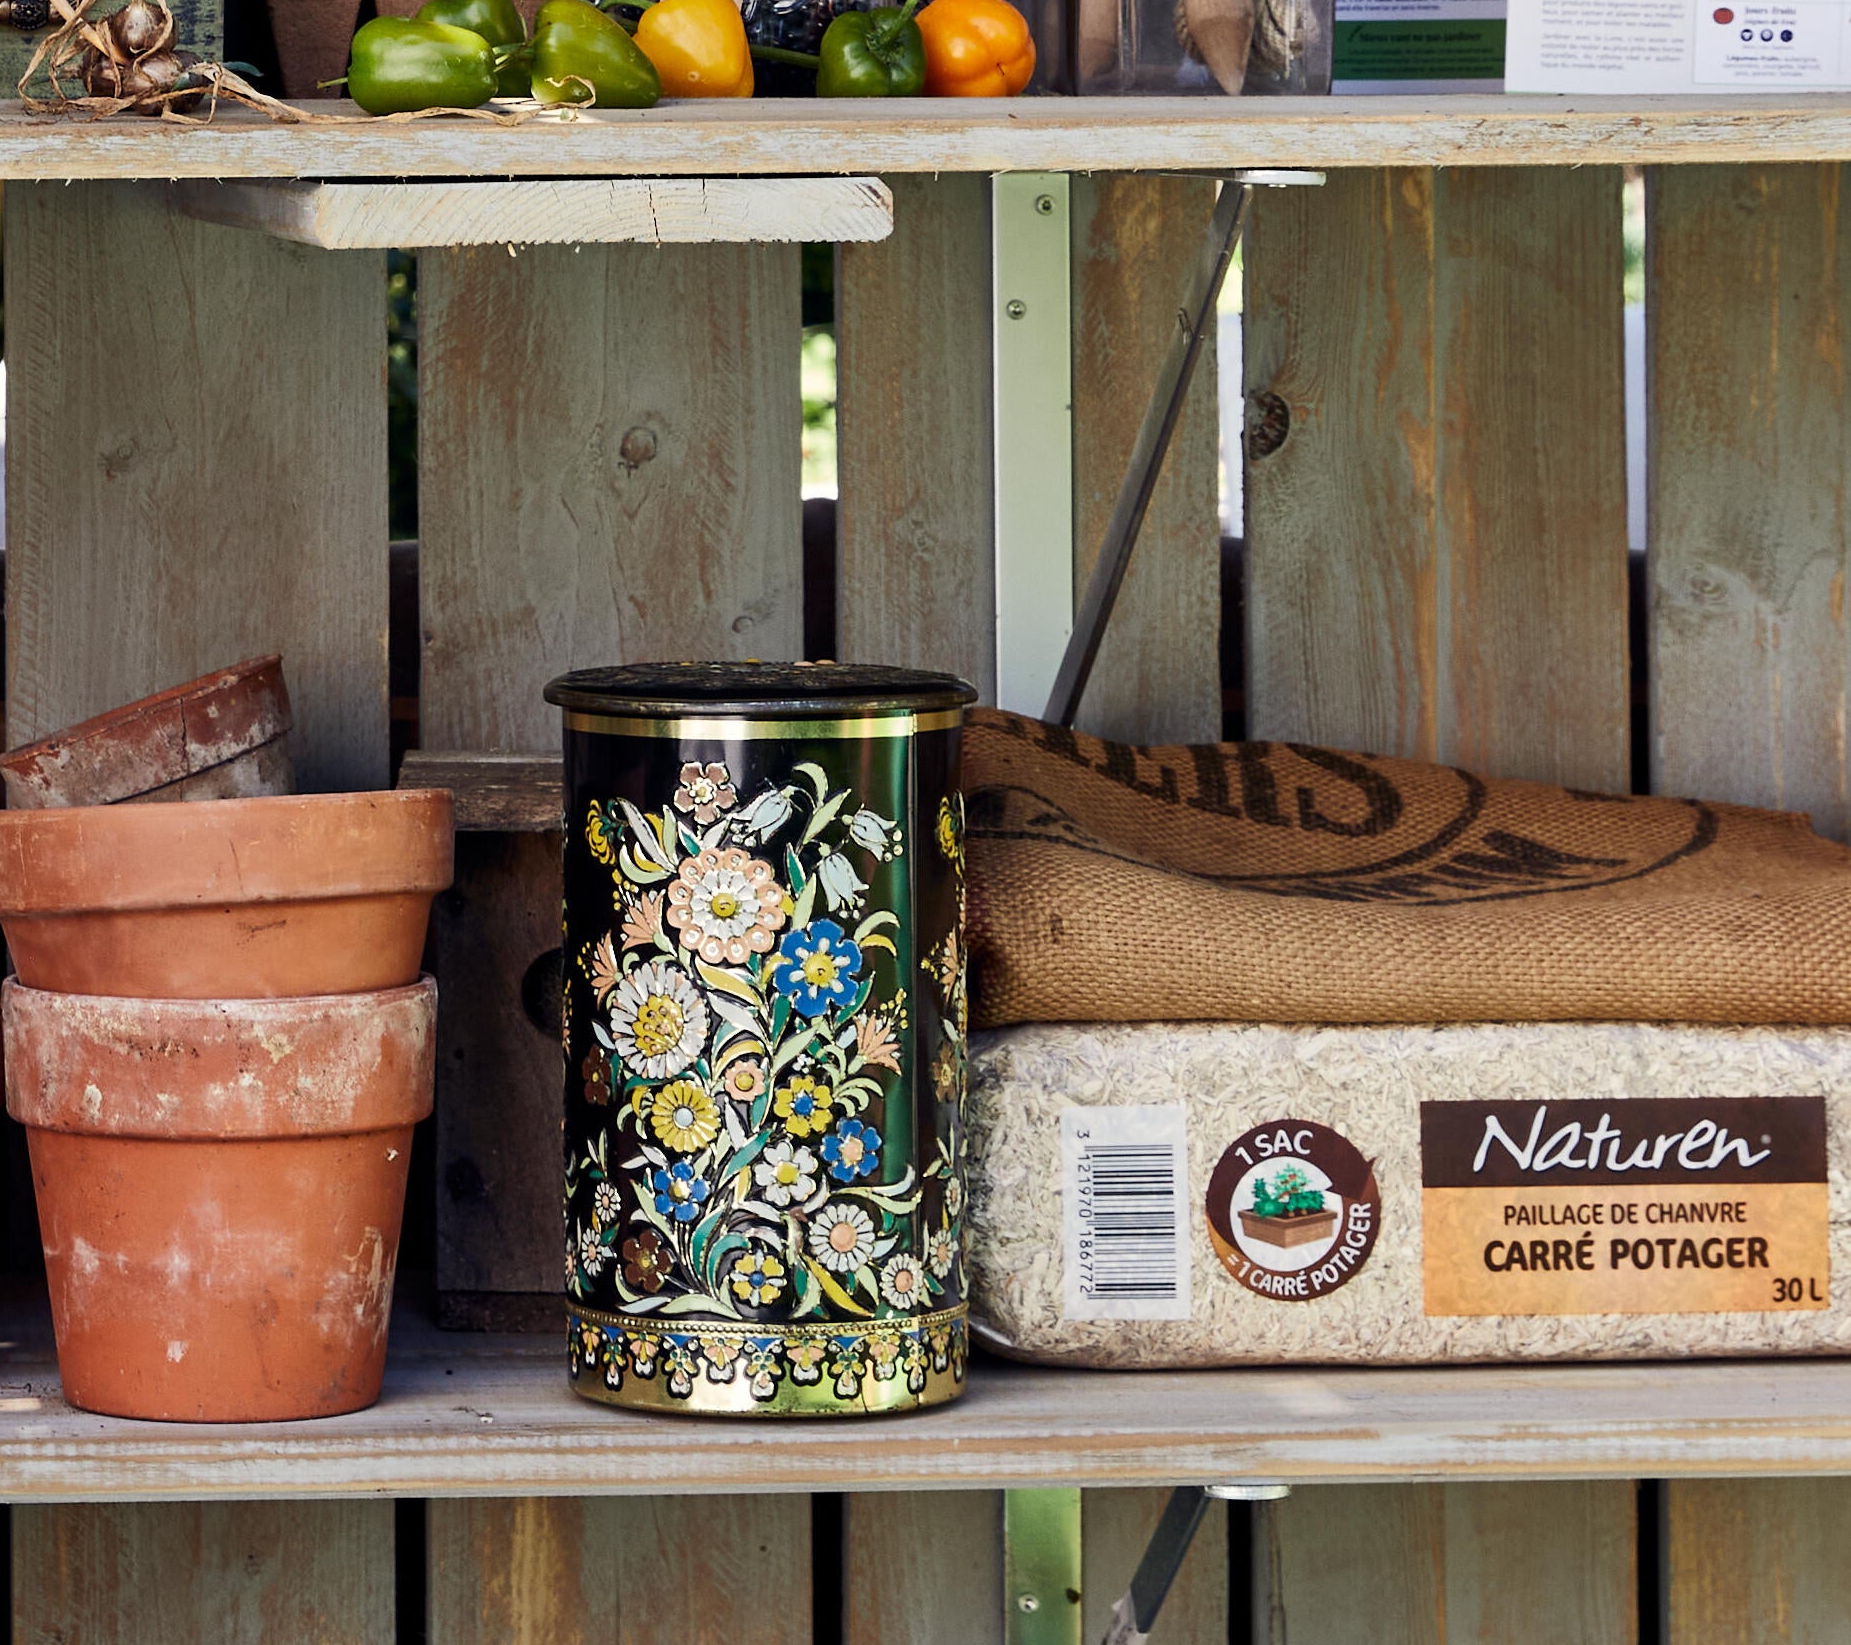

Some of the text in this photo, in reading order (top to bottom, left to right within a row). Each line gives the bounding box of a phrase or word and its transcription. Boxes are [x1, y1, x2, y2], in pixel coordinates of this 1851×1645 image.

[1235, 1129, 1313, 1165] 1 SAC
[1473, 1105, 1771, 1172] Naturen
[1076, 1130, 1094, 1294] 3 121970 186772
[1504, 1202, 1747, 1226] PAILLAGE DE CHANVRE
[1250, 1269, 1309, 1296] CARRÉ
[1310, 1202, 1372, 1292] POTAGER
[1483, 1231, 1770, 1272] CARRÉ POTAGER
[1772, 1277, 1823, 1302] 30 L
